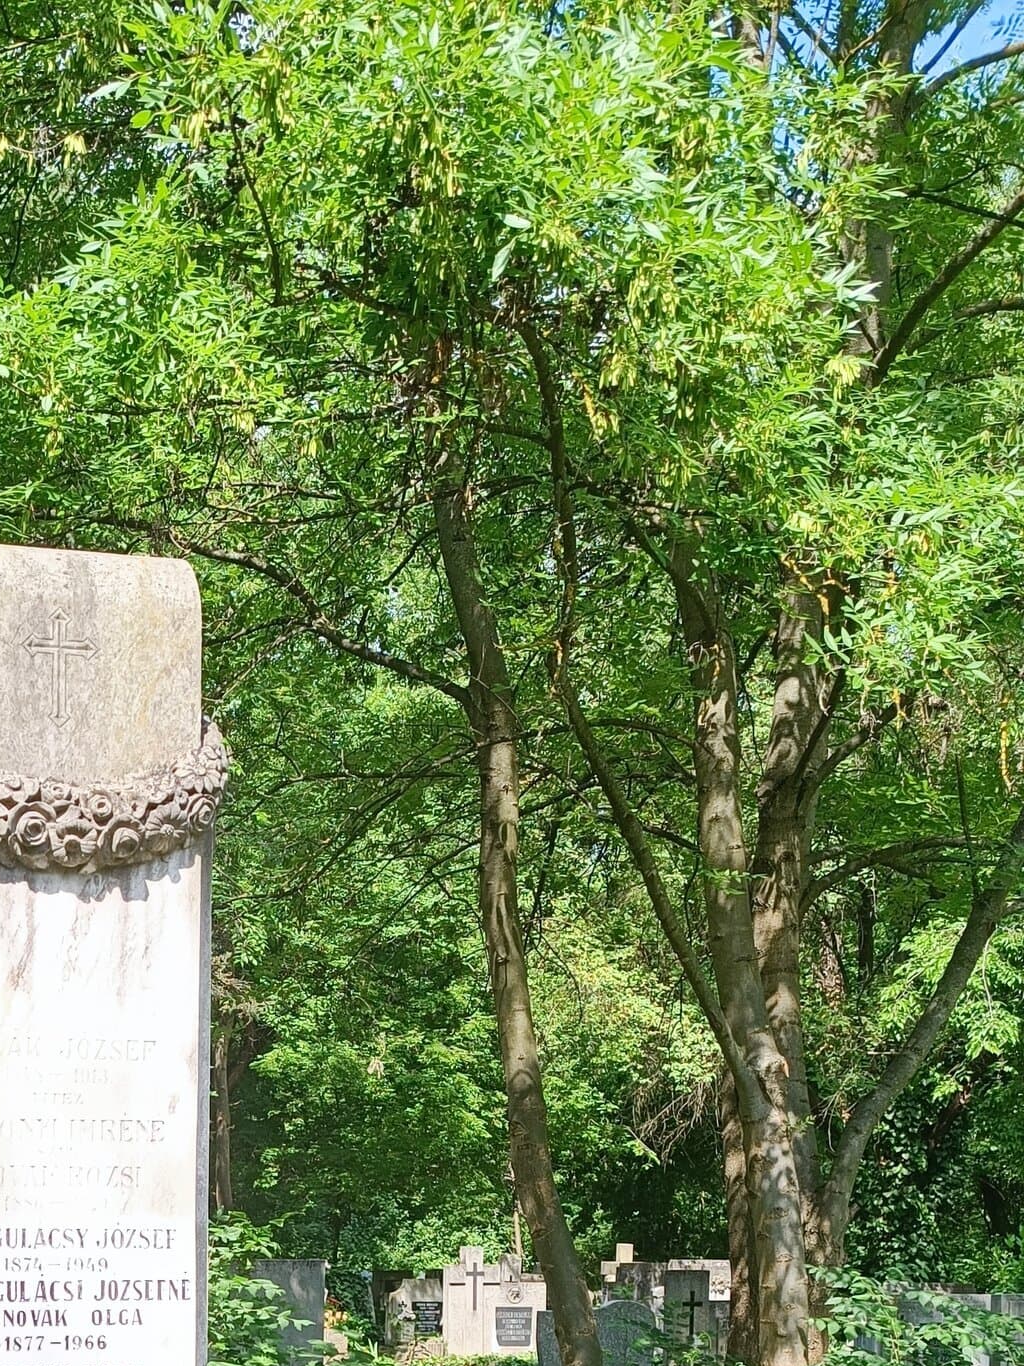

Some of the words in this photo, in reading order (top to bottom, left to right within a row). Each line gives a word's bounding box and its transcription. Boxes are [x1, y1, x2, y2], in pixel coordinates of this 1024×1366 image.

[91, 1308, 144, 1327] OLGA
[4, 1336, 45, 1351] 1877
[65, 1335, 108, 1351] 1966
